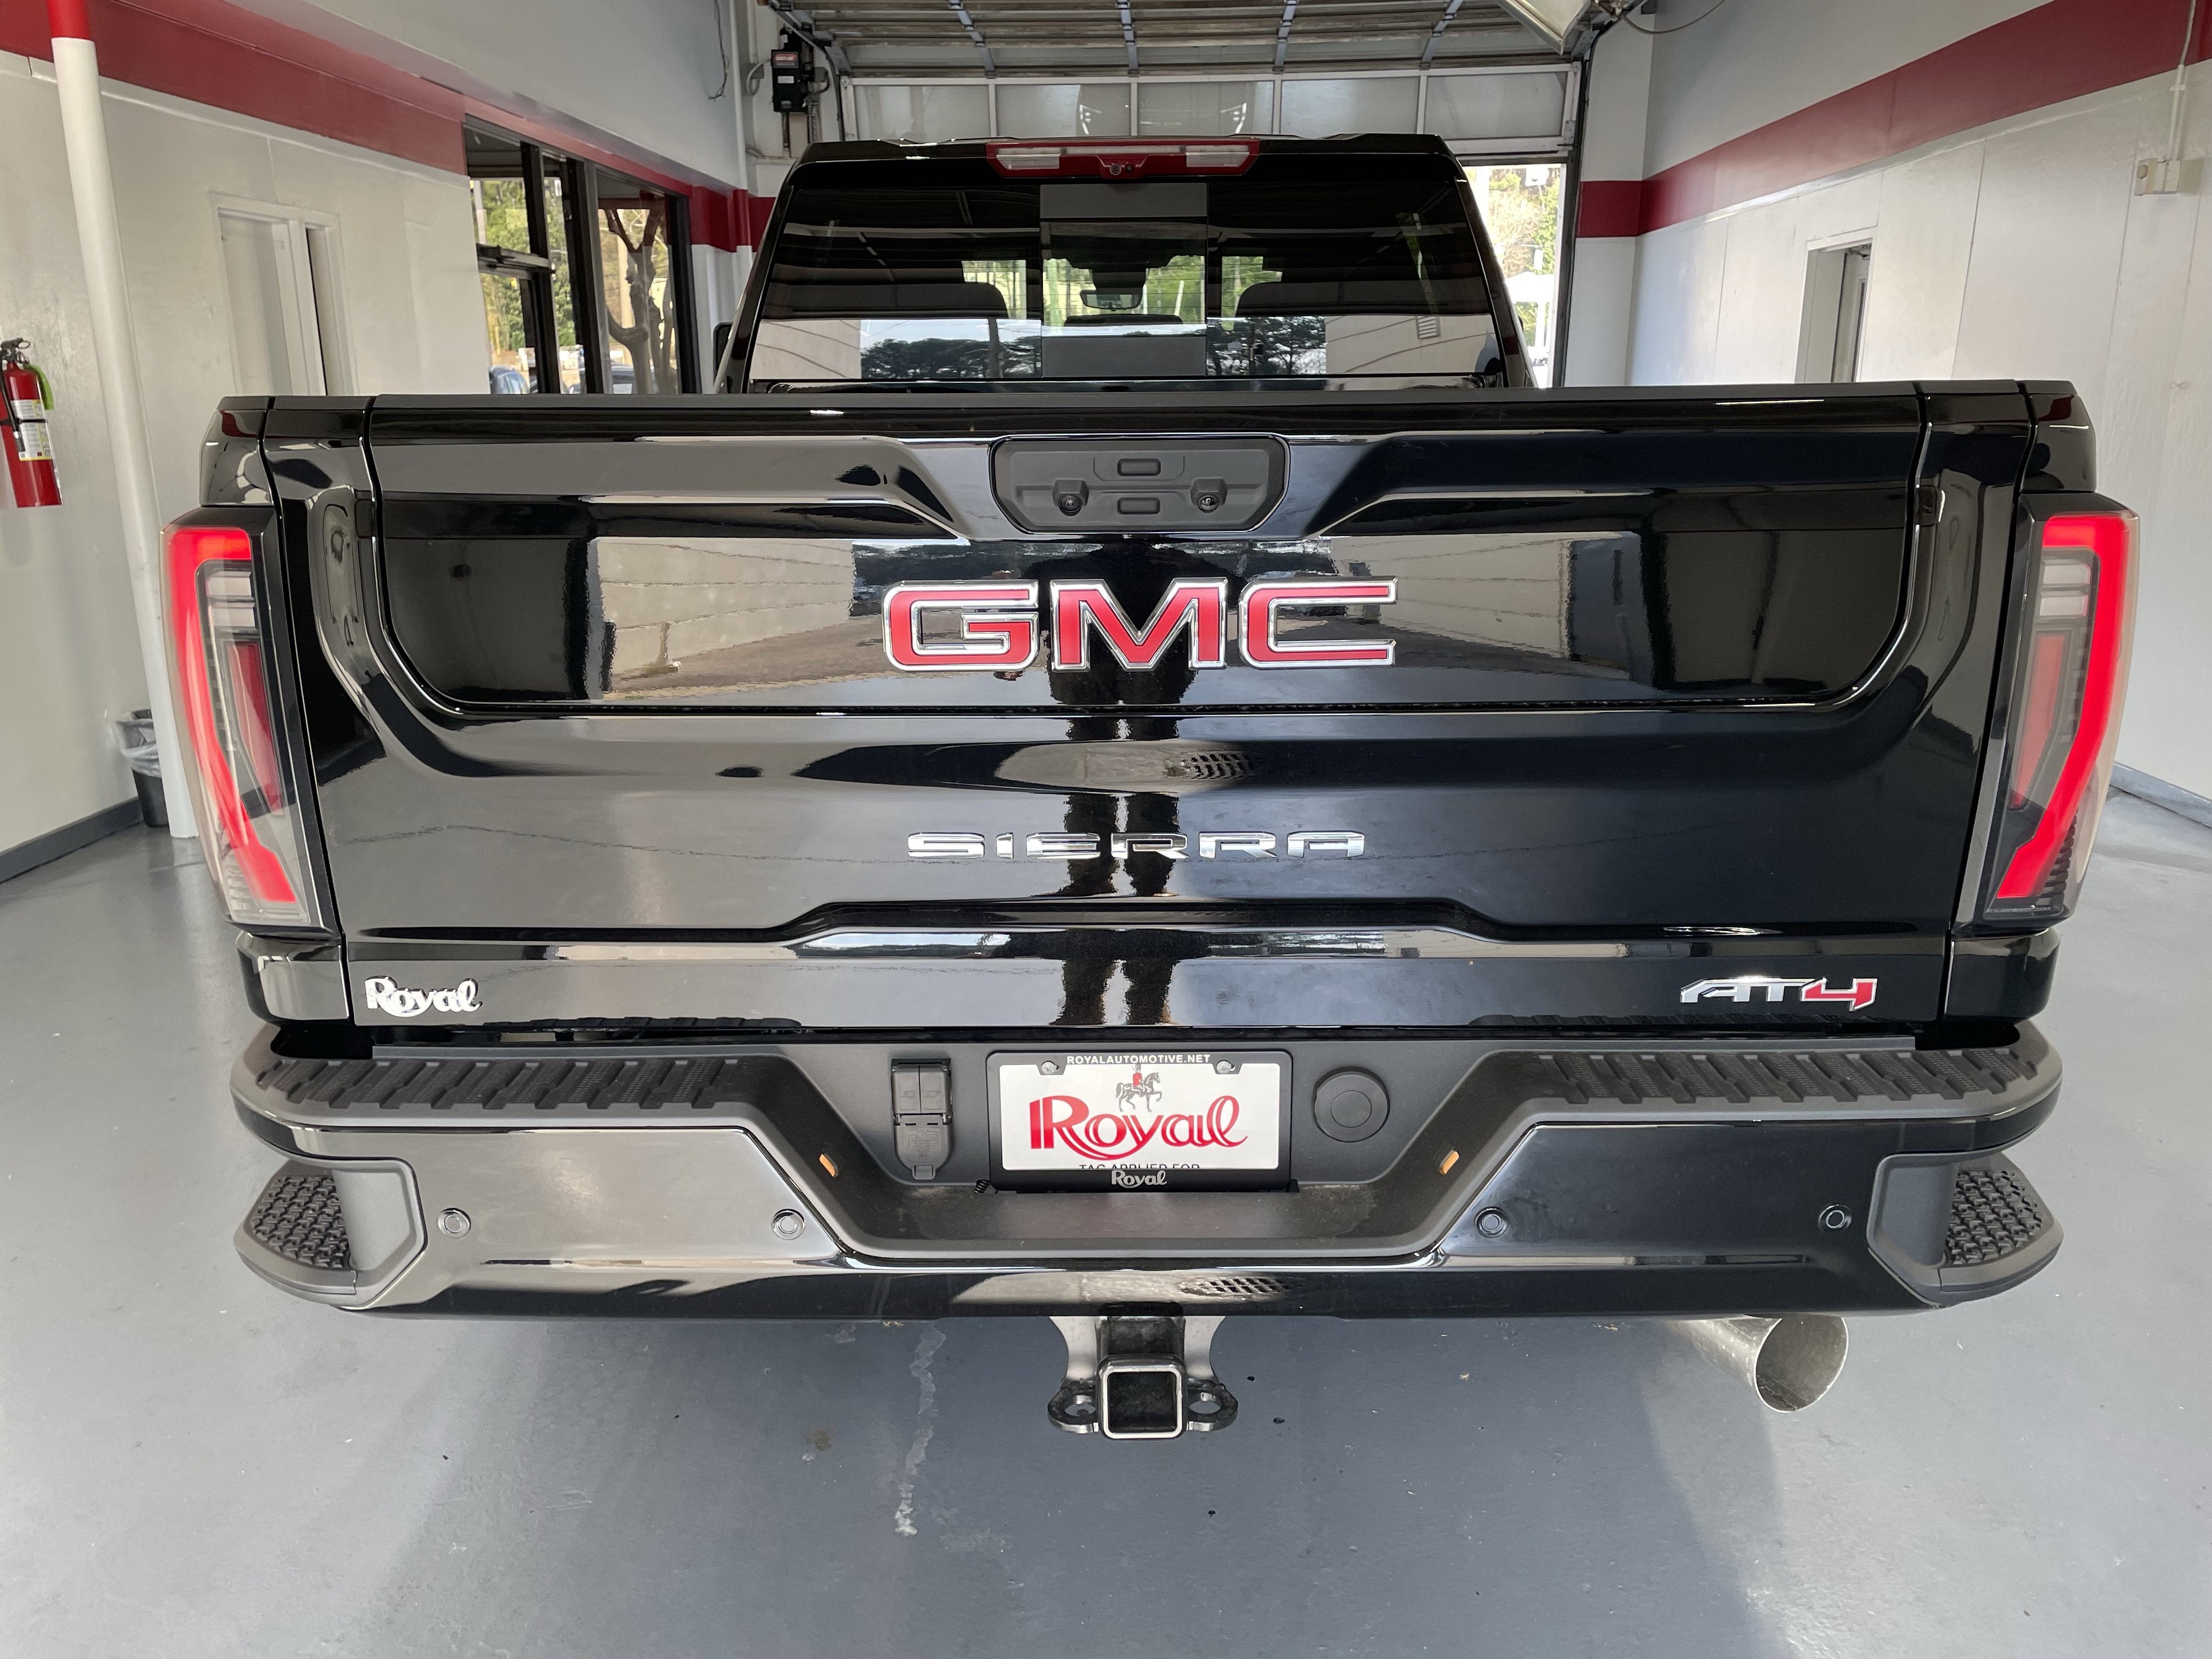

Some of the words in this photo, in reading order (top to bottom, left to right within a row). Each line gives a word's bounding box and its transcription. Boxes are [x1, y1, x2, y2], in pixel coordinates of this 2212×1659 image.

[883, 578, 1398, 671] GMC
[907, 831, 1365, 860] SIERRA
[365, 975, 483, 1017] Royal
[1680, 977, 1878, 1012] AT4
[1066, 1054, 1211, 1064] ROYALAUTOMOTIVE.NET
[1030, 1095, 1248, 1160] Royal
[1111, 1170, 1167, 1188] Royal
